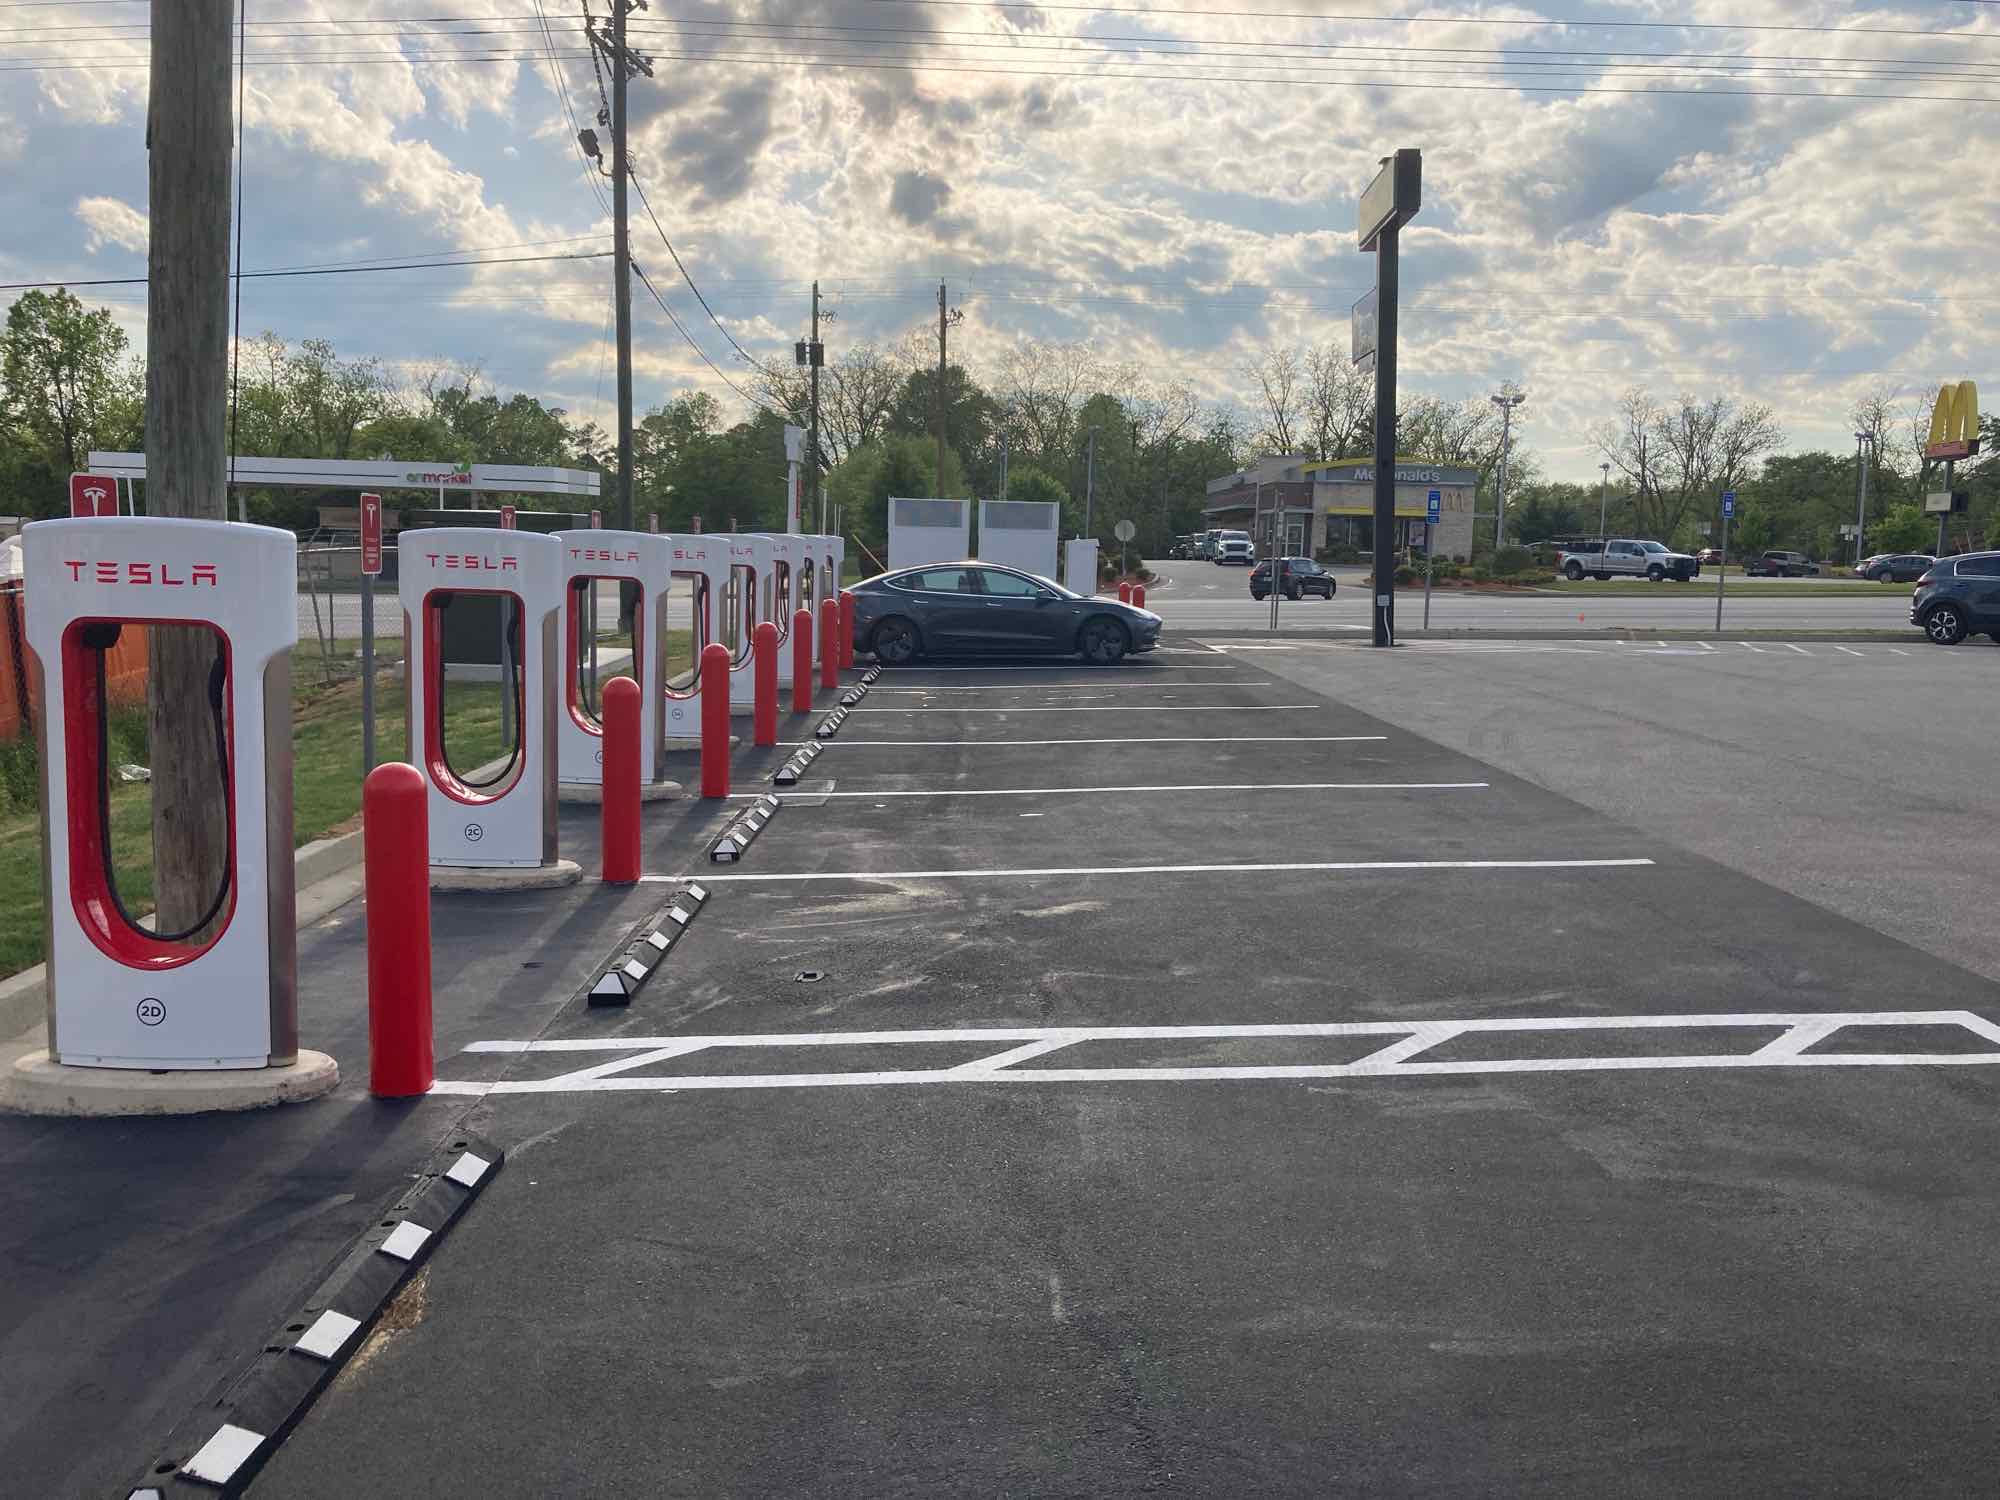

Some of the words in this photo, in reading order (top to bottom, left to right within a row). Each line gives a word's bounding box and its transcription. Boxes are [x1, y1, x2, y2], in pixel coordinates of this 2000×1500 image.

[1354, 468, 1440, 481] Mcnald's
[569, 549, 640, 562] TESLA
[673, 550, 706, 560] SLA
[425, 554, 518, 570] TESLA
[64, 561, 217, 586] TESLA
[141, 1005, 161, 1017] 2D
